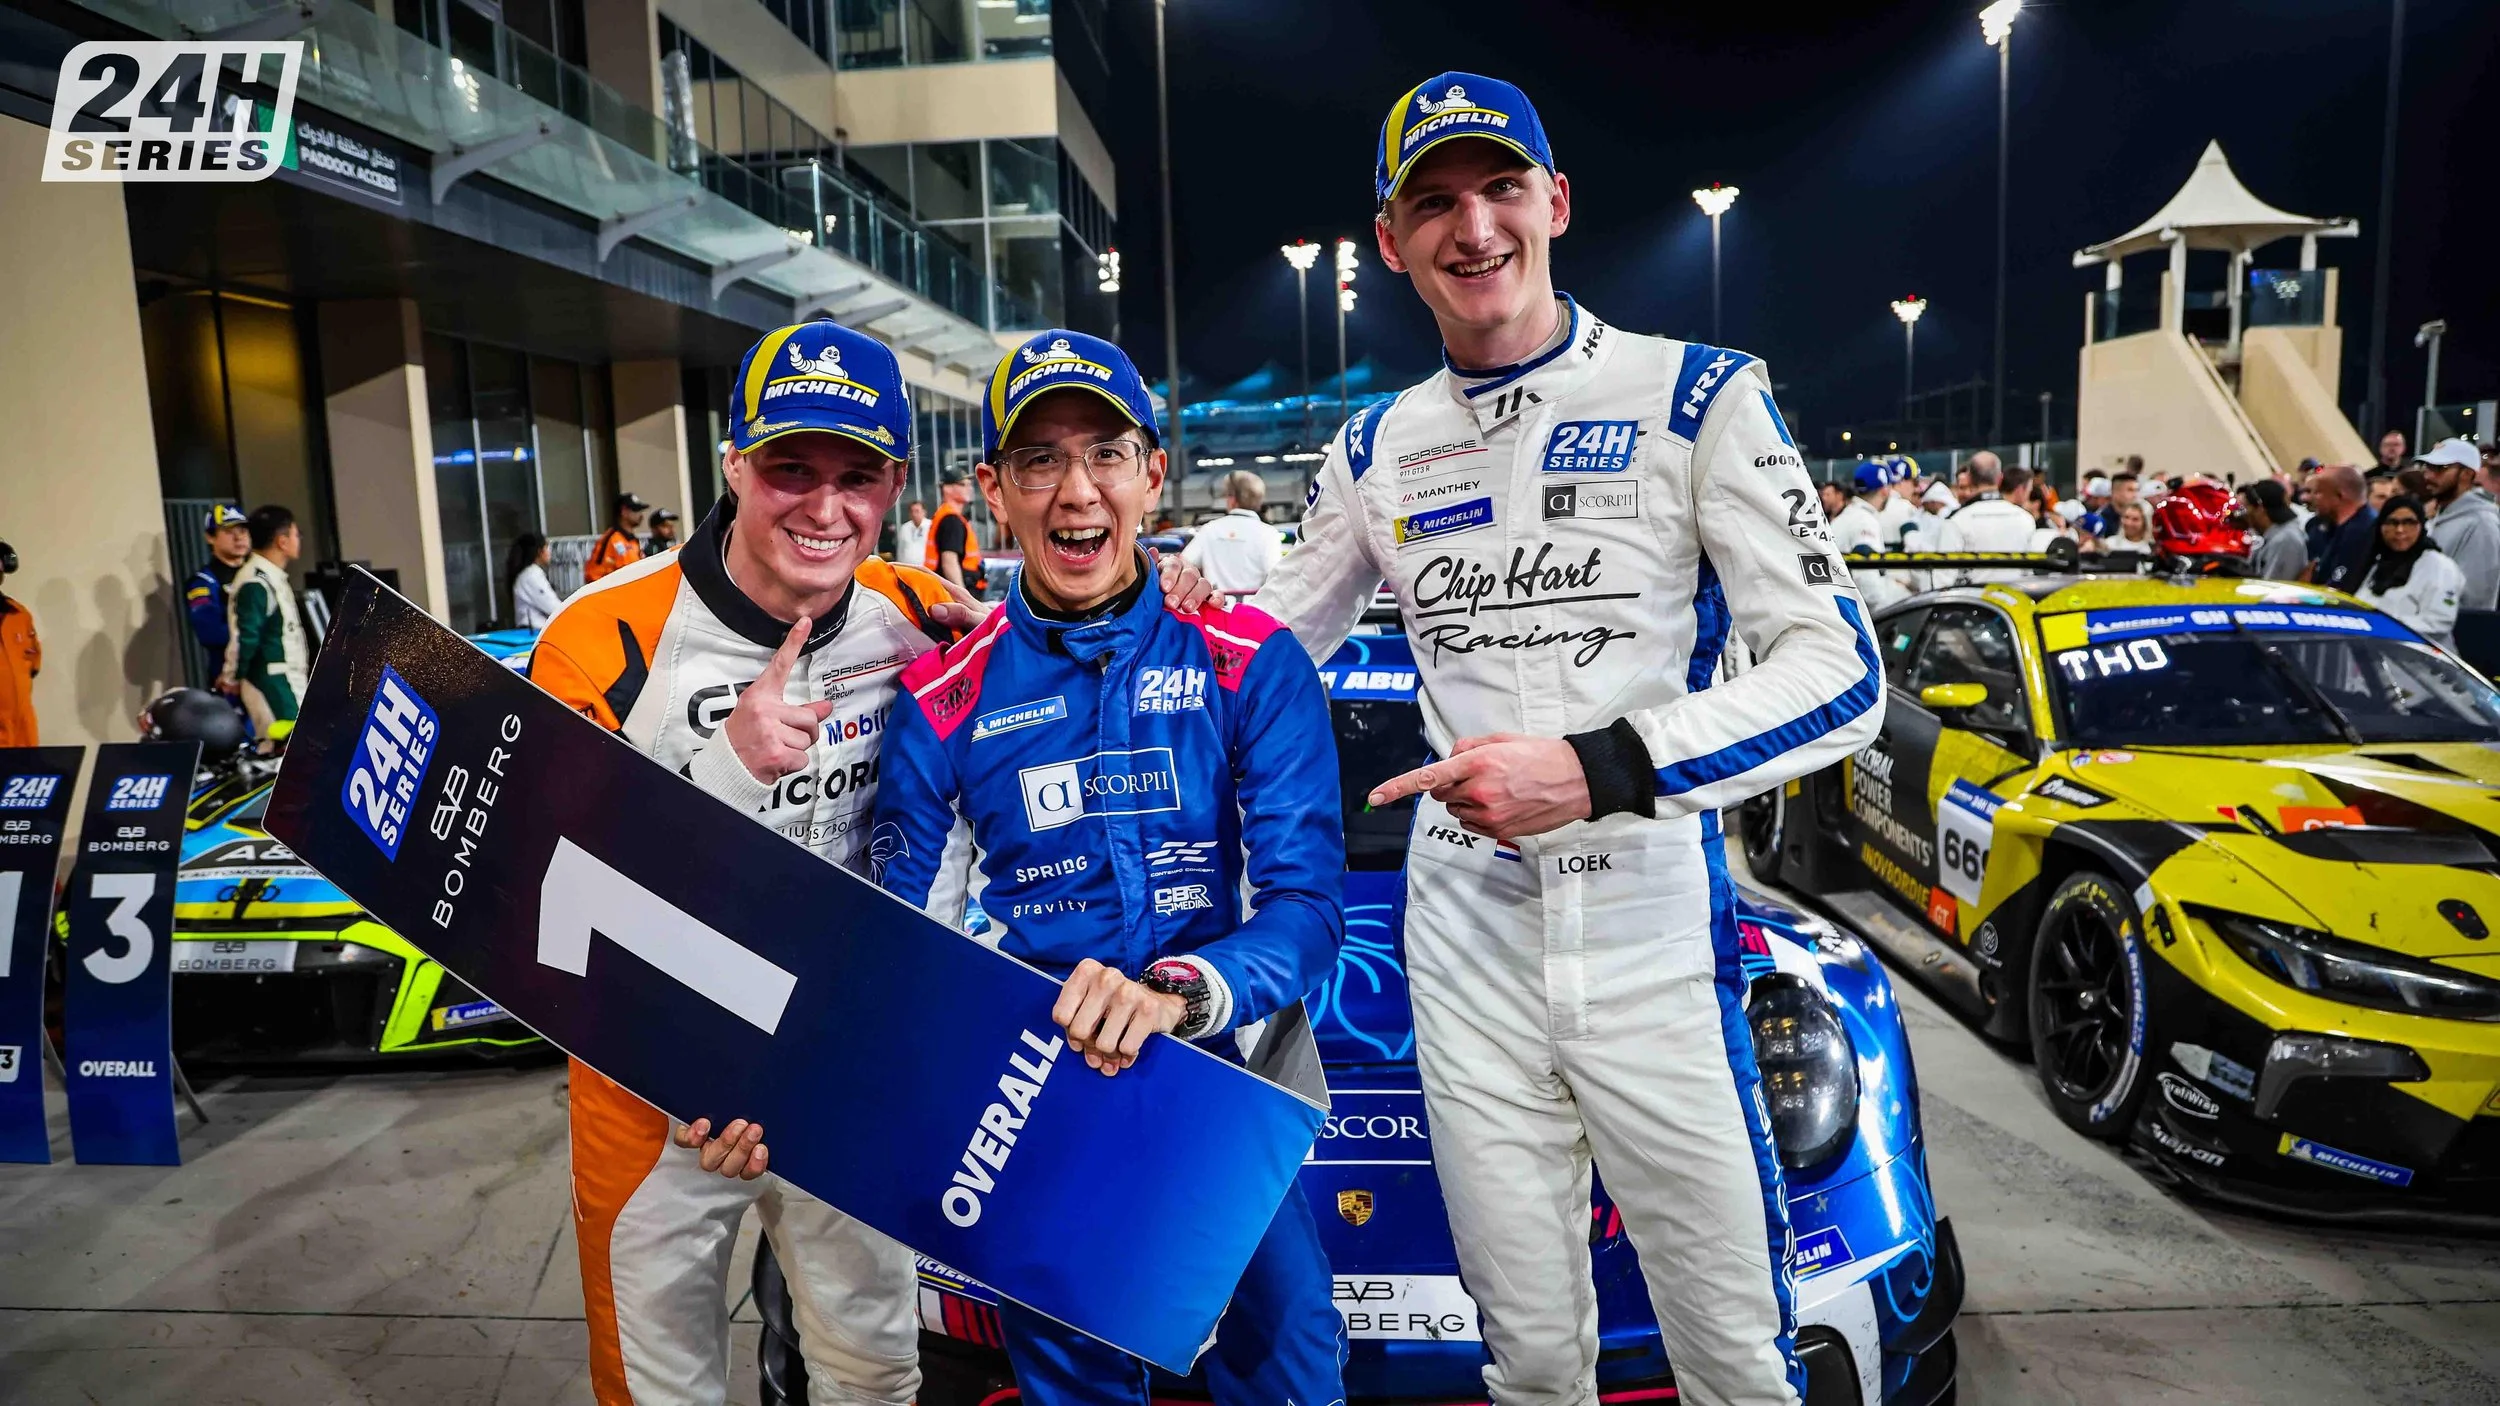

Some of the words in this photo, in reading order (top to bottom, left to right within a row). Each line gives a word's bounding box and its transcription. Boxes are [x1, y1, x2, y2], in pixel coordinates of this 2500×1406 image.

[1404, 112, 1509, 151] MICHELIN
[300, 146, 357, 178] PADDOCK
[356, 165, 398, 193] ACCESS
[1009, 360, 1113, 400] MICHELIN
[1681, 352, 1736, 419] HRX
[764, 382, 879, 408] MICHELIN
[1398, 440, 1477, 464] PORSCHE
[1552, 425, 1633, 454] 24H
[1400, 469, 1411, 478] 911
[1412, 466, 1425, 476] GT3
[1549, 456, 1624, 469] SERIES
[1417, 480, 1480, 500] MANTHEY
[1579, 494, 1632, 508] SCORPII
[1422, 507, 1484, 530] MICHELIN
[1413, 554, 1497, 617] Chip
[1503, 542, 1602, 600] Hart
[2233, 610, 2290, 625] ABU
[2290, 611, 2373, 632] DHABI
[1419, 624, 1637, 669] Racing
[2058, 638, 2169, 681] THO
[822, 654, 900, 682] PORSCHE
[1140, 667, 1207, 700] 24H
[1341, 672, 1416, 691] ABU
[1138, 695, 1205, 712] SERIES
[825, 707, 887, 747] Mobil
[988, 705, 1056, 729] MICHELIN
[349, 678, 421, 832] 24H
[1853, 747, 1895, 786] GLOBAL
[4, 777, 58, 798] 24H
[112, 776, 169, 799] 24H
[380, 716, 436, 847] SERIES
[1083, 771, 1170, 797] SCORPII
[1852, 766, 1893, 815] POWER
[0, 798, 49, 808] SERIES
[108, 798, 161, 809] SERIES
[432, 713, 522, 929] BOMBERG
[88, 840, 171, 852] BOMBERG
[1427, 825, 1480, 849] HRX
[1150, 868, 1184, 878] CONTEMPO
[1558, 853, 1613, 875] LOEK
[1013, 900, 1087, 919] gravity
[1173, 900, 1206, 911] MEDIA
[1933, 903, 1950, 929] GT
[82, 873, 154, 984] 3
[537, 835, 799, 1036] 1
[178, 959, 277, 971] BOMBERG
[79, 1060, 157, 1077] OVERALL
[941, 1028, 1064, 1228] OVERALL
[2314, 1150, 2400, 1180] MICHELIN
